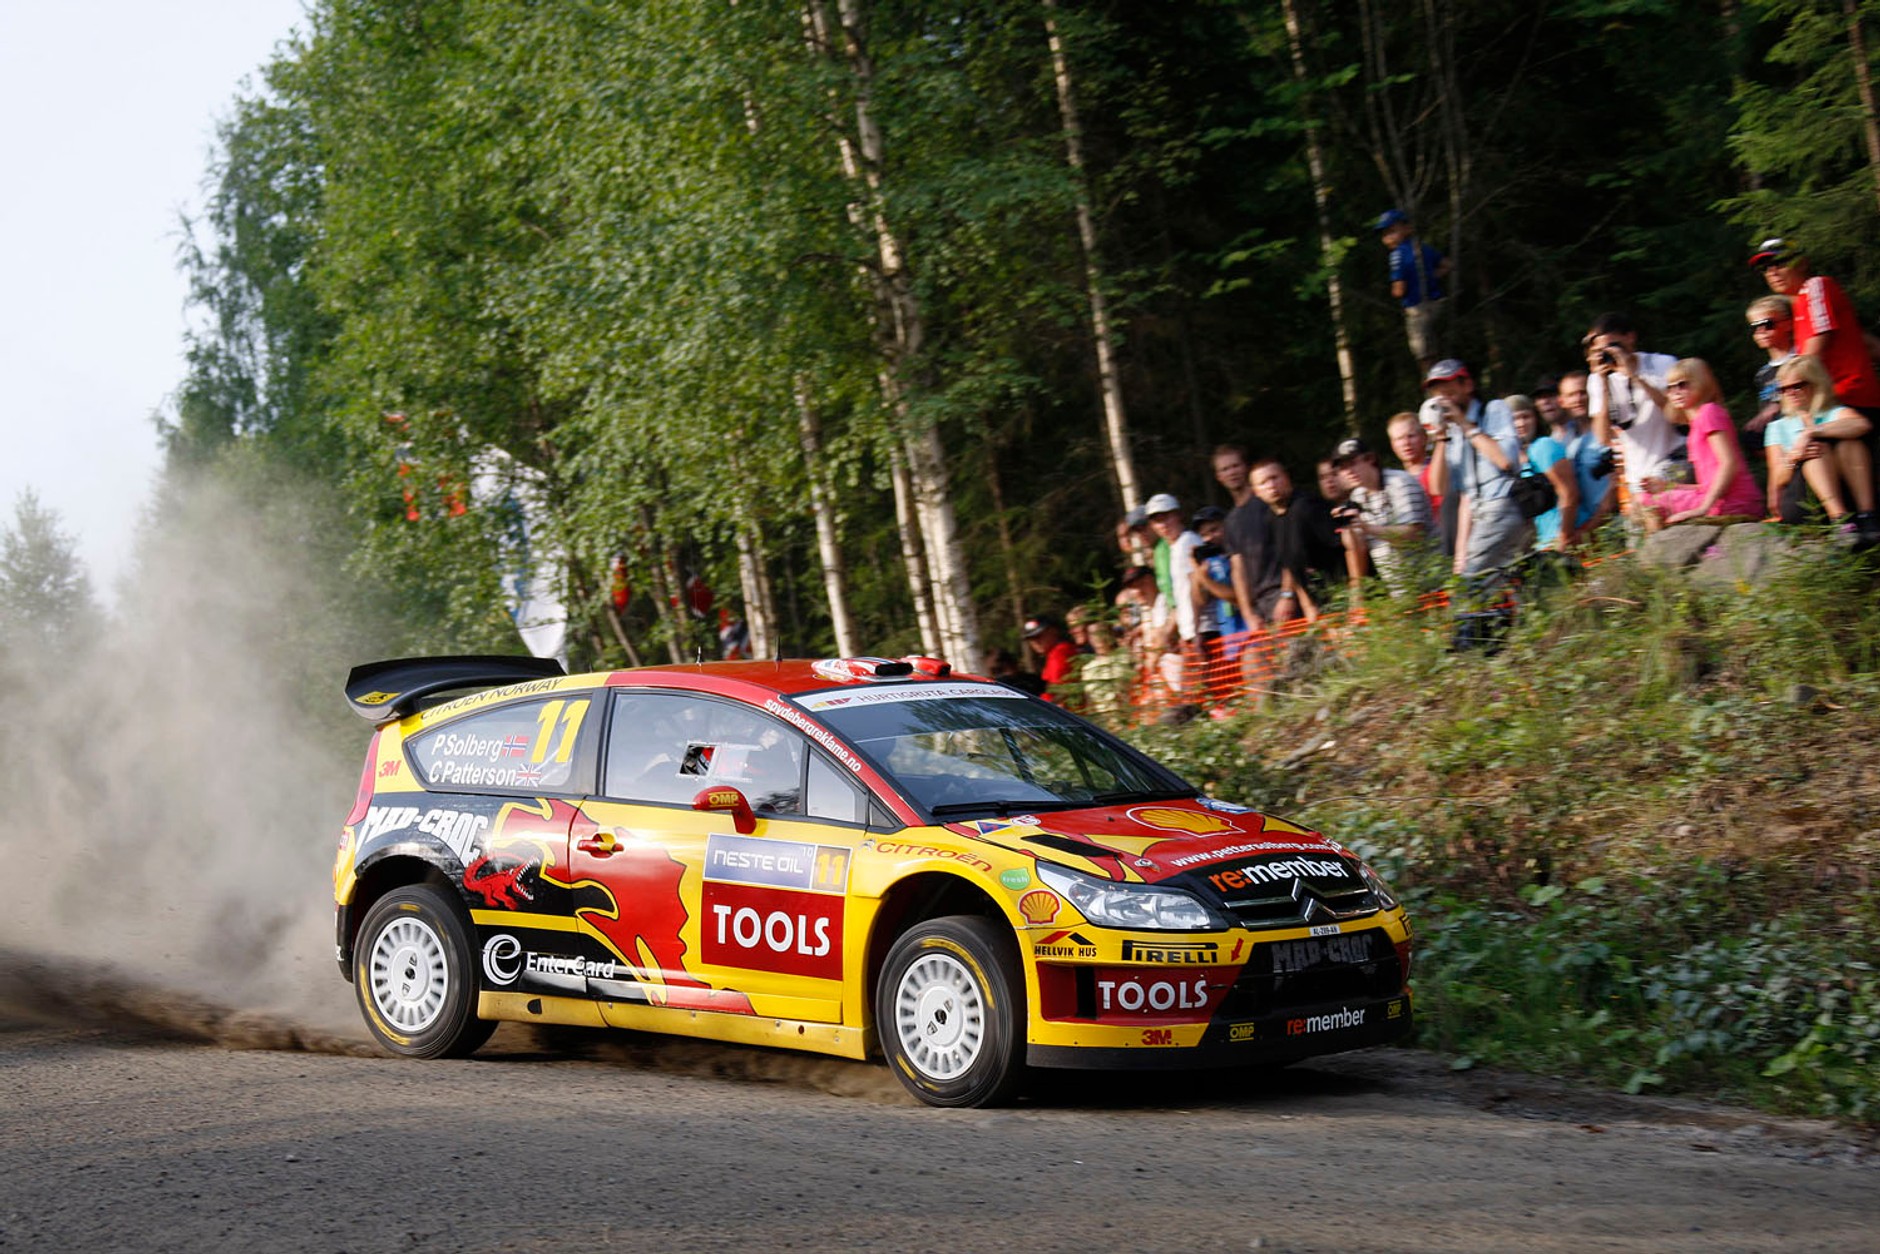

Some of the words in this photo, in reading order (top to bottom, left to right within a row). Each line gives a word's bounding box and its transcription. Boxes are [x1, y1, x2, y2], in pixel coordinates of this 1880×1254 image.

[490, 677, 565, 700] NORWAY
[531, 700, 592, 763] 11
[764, 698, 862, 772] spydebergreklame.no
[378, 760, 401, 778] 3M
[443, 761, 516, 786] Patterson
[708, 793, 739, 806] OMP
[777, 857, 804, 874] OIL
[817, 853, 845, 885] 11
[1208, 856, 1349, 893] re:member
[713, 904, 830, 956] TOOLS
[1034, 945, 1074, 957] HELLVIK
[1078, 947, 1097, 957] HUS
[1121, 940, 1218, 963] PIRELLI
[526, 952, 616, 978] EnterCard
[1098, 980, 1208, 1010] TOOLS
[1229, 1026, 1254, 1039] OMP
[1286, 1007, 1366, 1036] re:member
[1142, 1030, 1172, 1045] 3M
